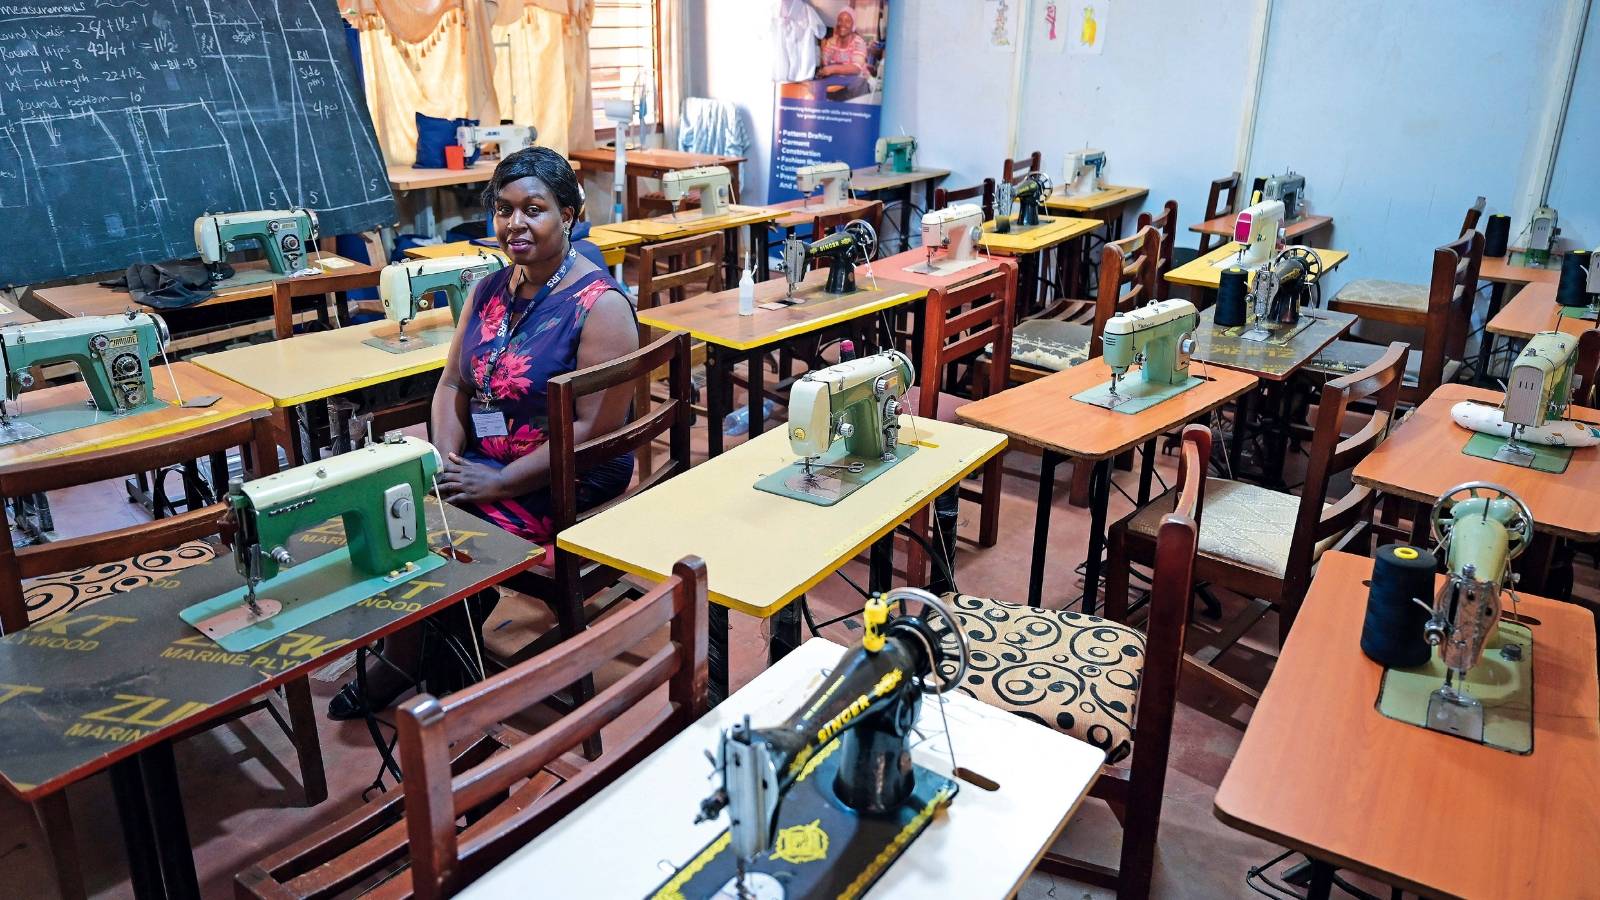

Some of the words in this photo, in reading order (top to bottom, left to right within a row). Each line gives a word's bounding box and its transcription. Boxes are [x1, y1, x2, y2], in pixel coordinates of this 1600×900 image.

[783, 129, 807, 138] Pattern
[808, 131, 833, 142] Drafting
[782, 147, 822, 158] Construction
[546, 272, 561, 288] JRS
[497, 320, 508, 338] JRS
[357, 598, 422, 613] WOOD
[160, 646, 250, 667] MARINE
[817, 694, 871, 744] SINGER
[63, 722, 152, 743] MARIN
